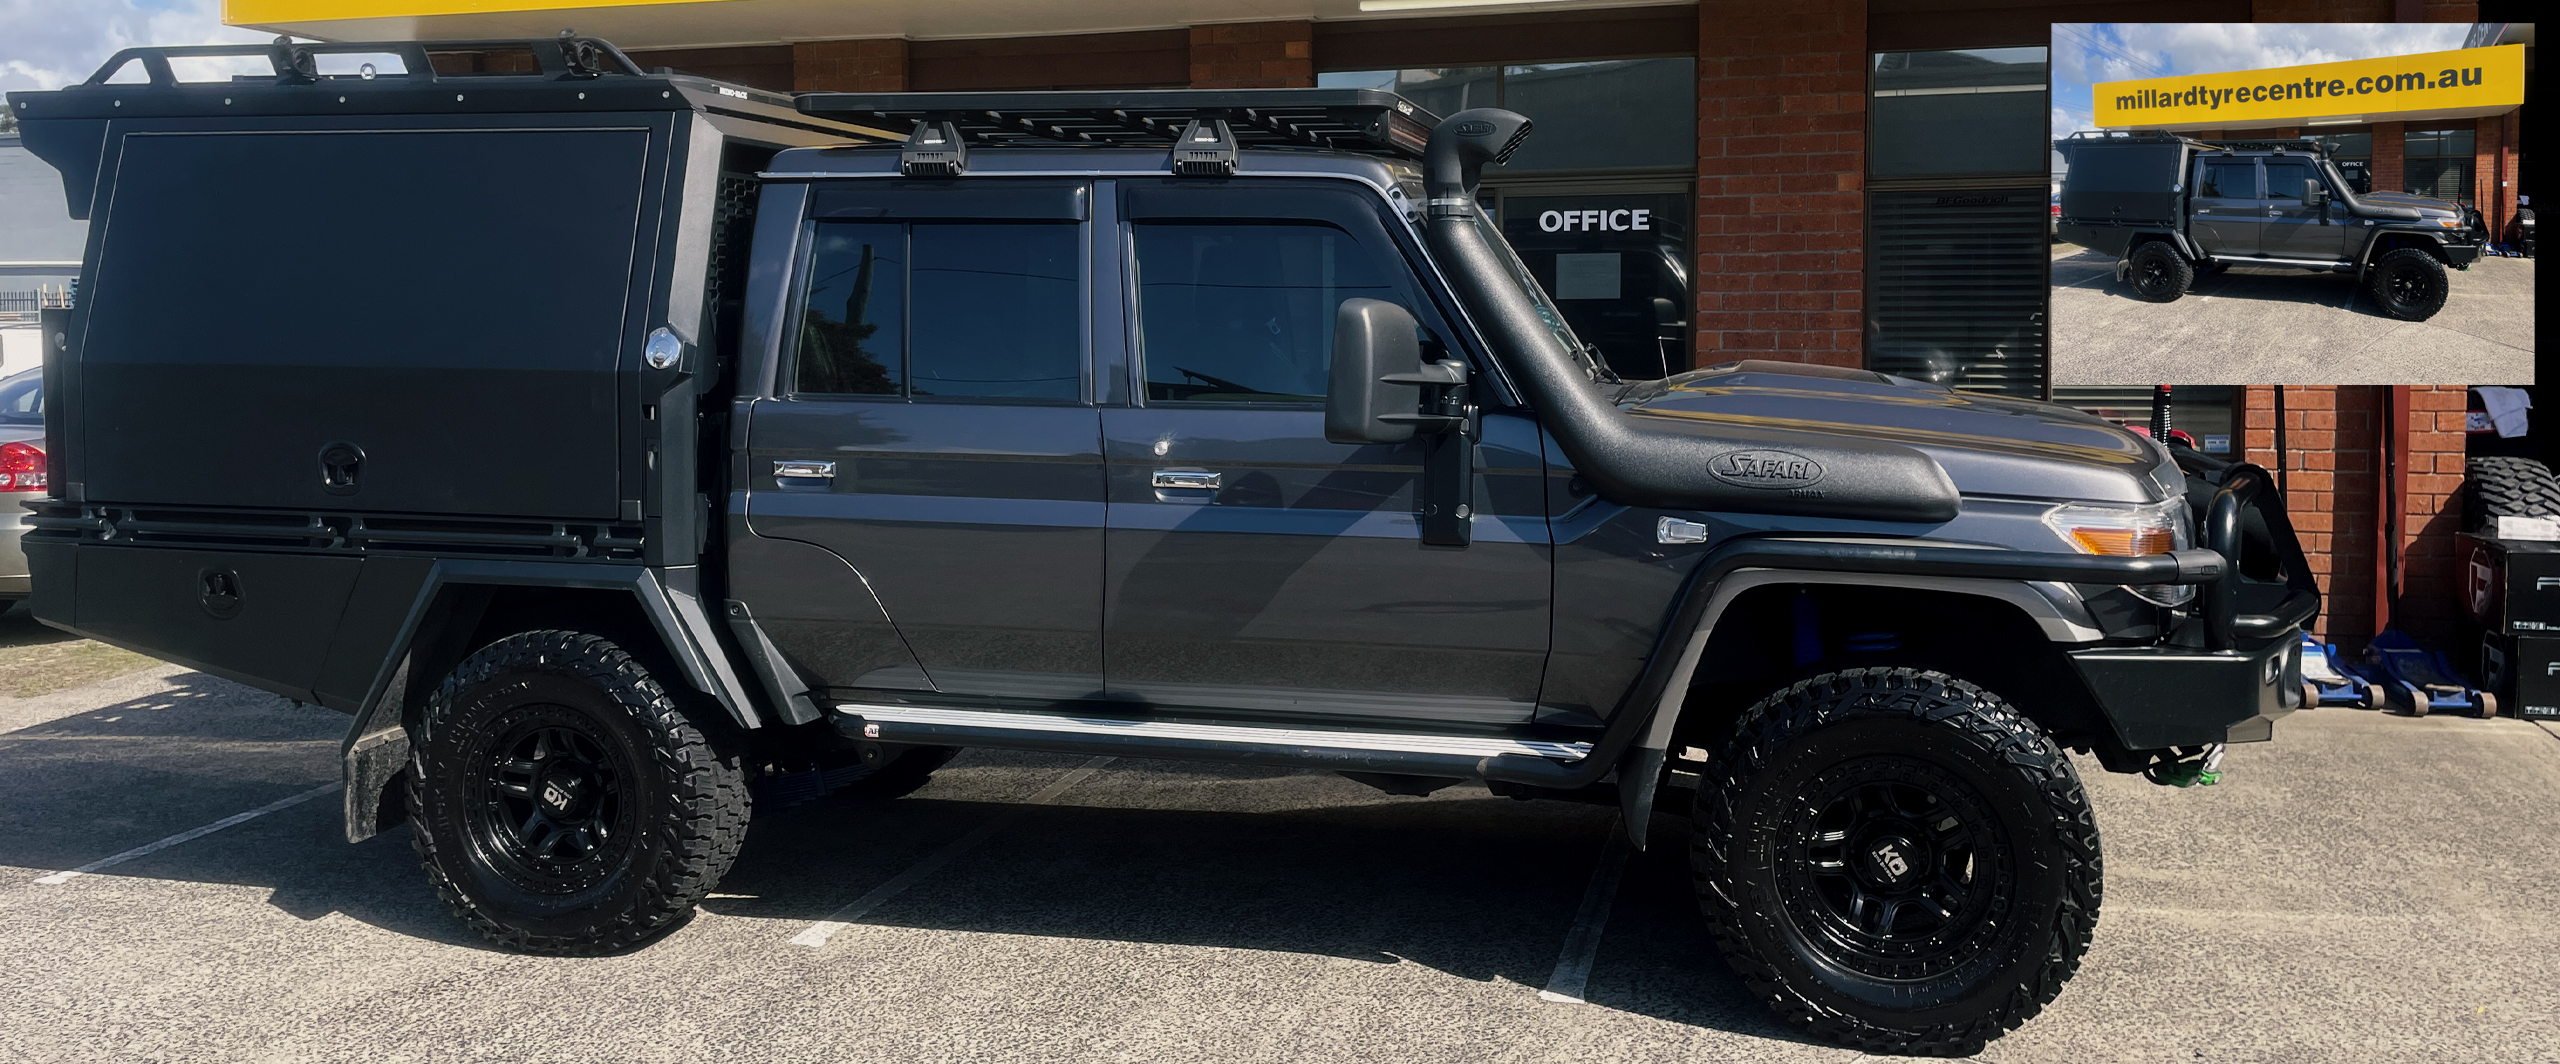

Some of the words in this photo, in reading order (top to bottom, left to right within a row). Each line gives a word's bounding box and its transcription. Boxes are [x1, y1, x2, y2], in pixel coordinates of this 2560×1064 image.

[2116, 67, 2482, 110] millardtyrecentre.com.au
[1538, 208, 1651, 233] OFFICE
[1721, 453, 1811, 480] SAFARI
